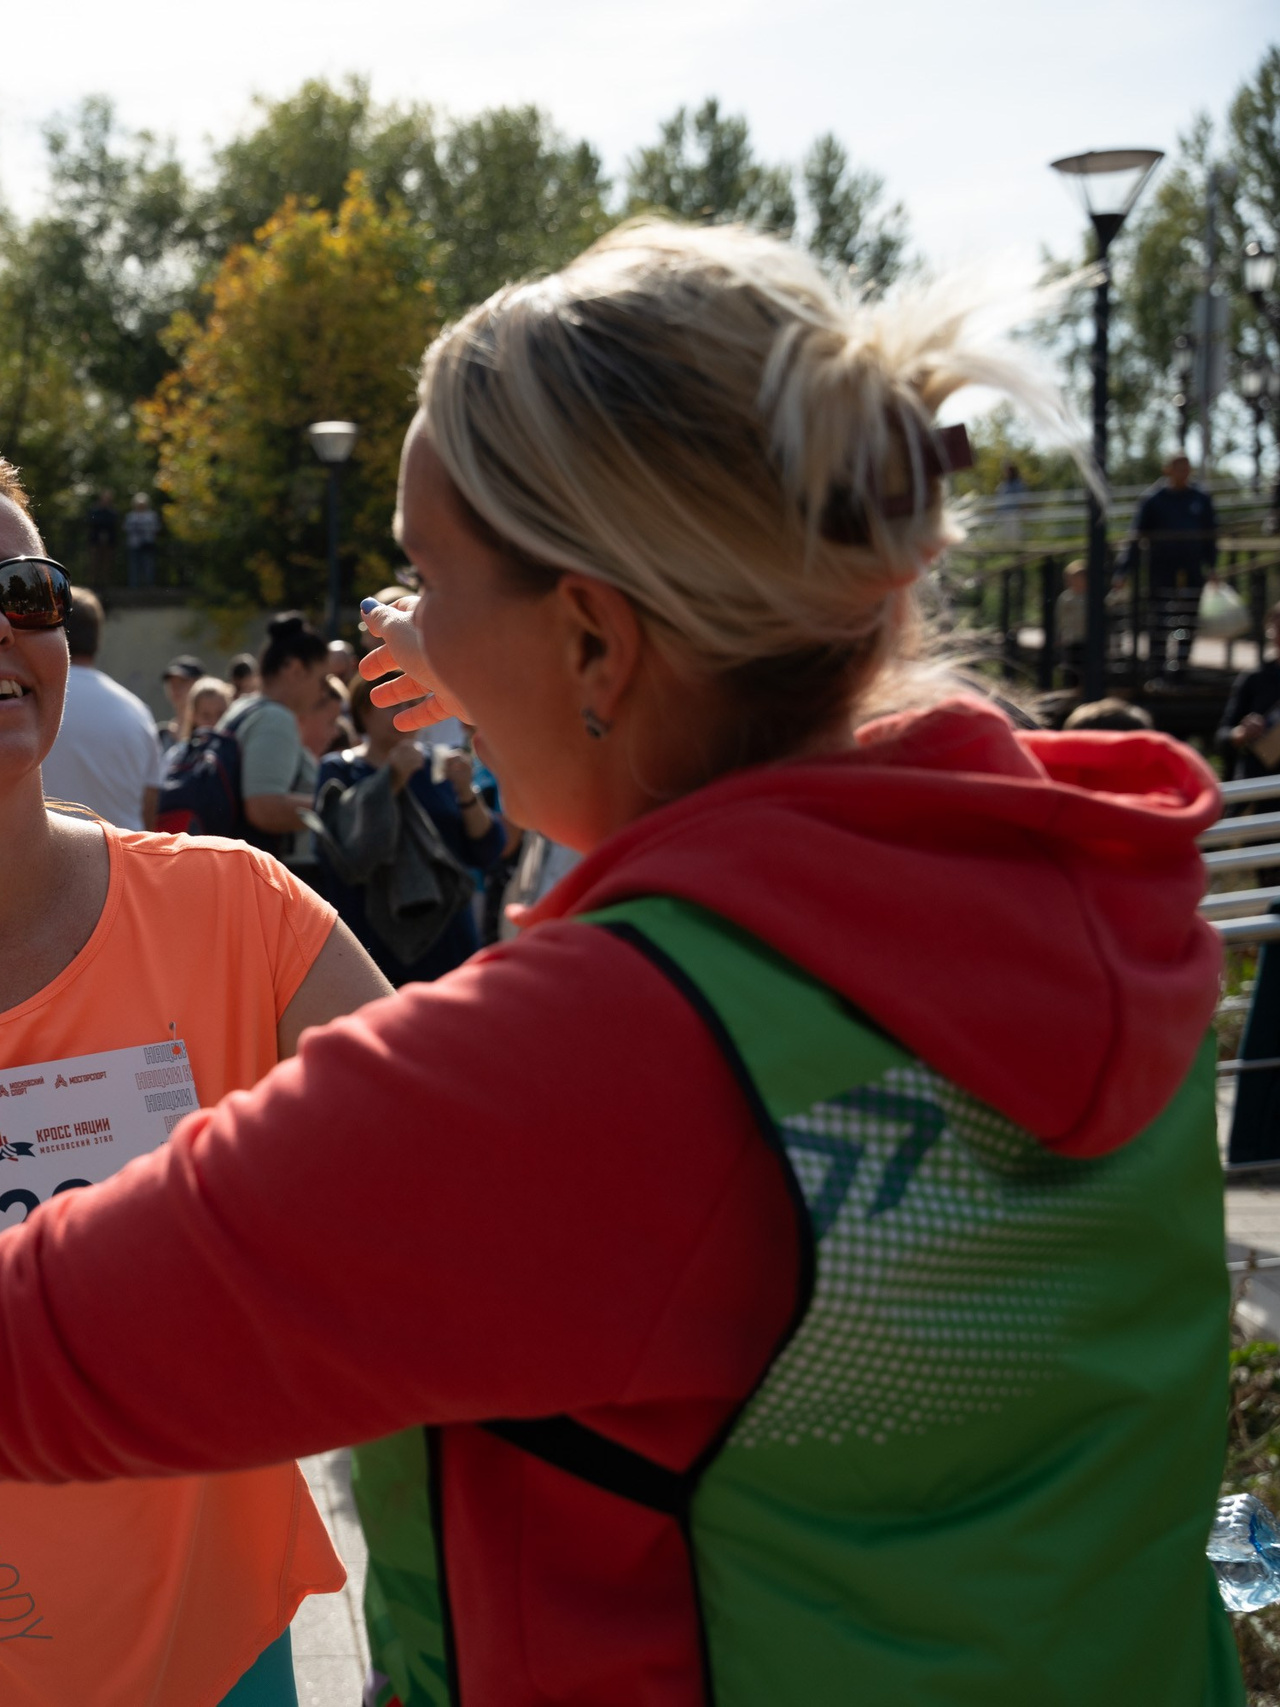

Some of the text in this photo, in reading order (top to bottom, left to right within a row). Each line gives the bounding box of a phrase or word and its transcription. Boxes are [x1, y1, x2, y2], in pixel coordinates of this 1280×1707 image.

[135, 1065, 183, 1090] НАЦИИ
[144, 1088, 193, 1113] НАЦИИ
[36, 1118, 111, 1143] КРОСС НАЦИИ
[40, 1135, 114, 1154] МОСКОВСКИЙ ЭТАП
